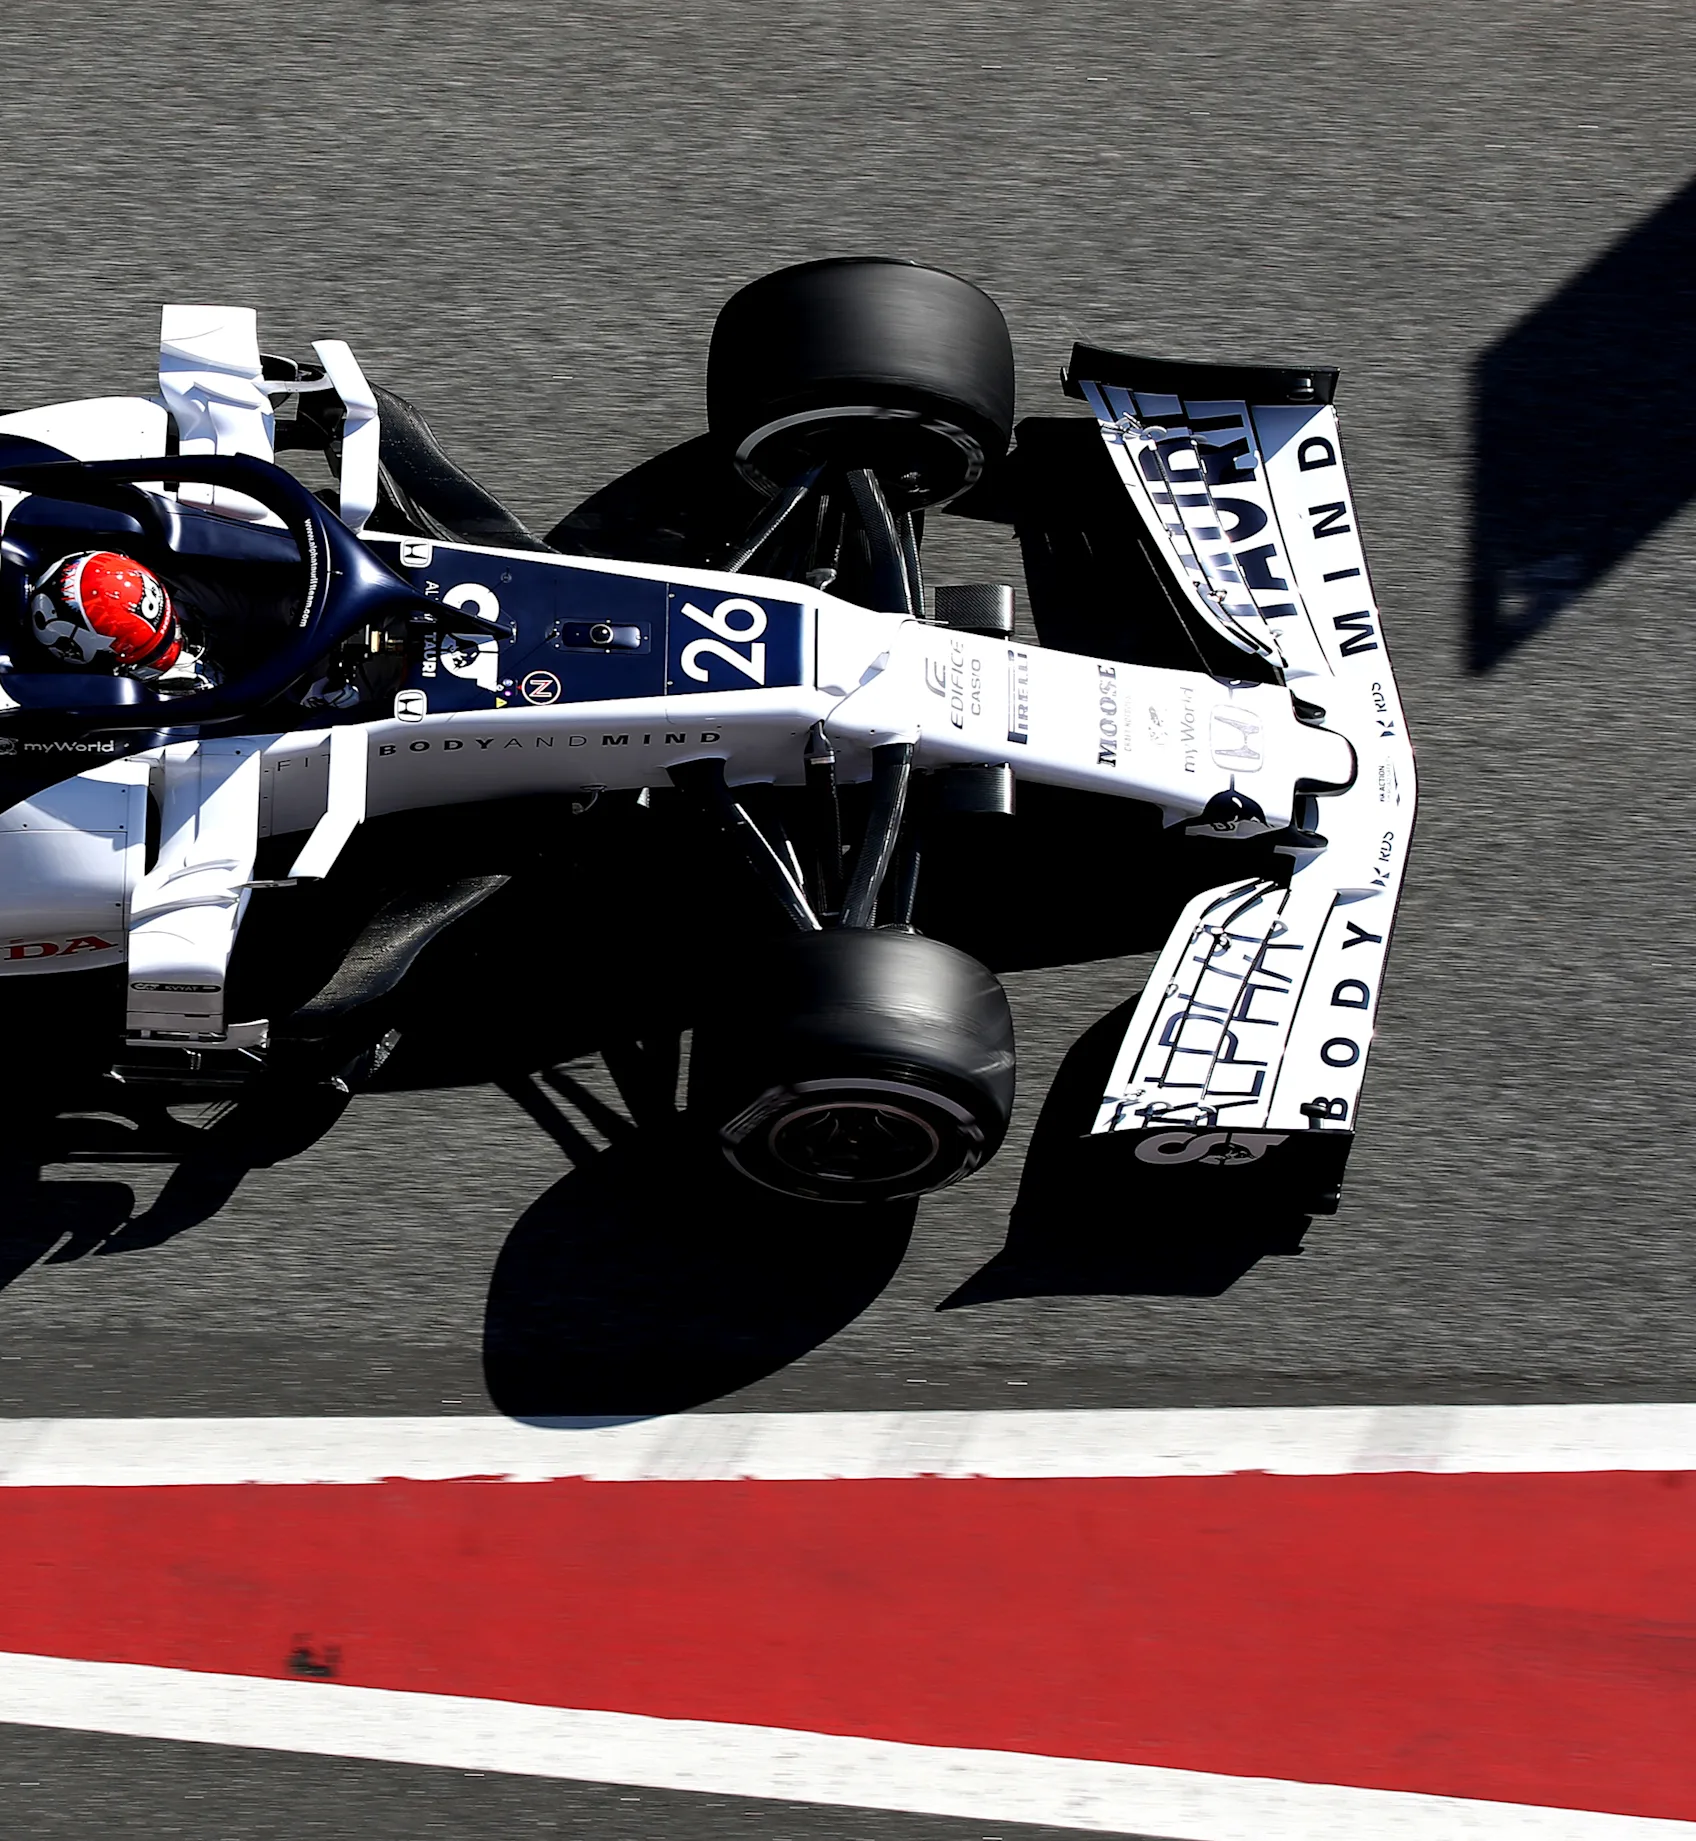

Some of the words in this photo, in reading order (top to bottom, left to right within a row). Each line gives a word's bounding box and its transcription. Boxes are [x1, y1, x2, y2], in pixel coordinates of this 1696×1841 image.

[1298, 436, 1378, 658] MIND
[680, 597, 767, 686] 26
[950, 639, 964, 730] EDIFICE
[971, 659, 981, 716] CASIO
[1096, 664, 1118, 768] MOOSE
[24, 740, 115, 754] myWorld
[1378, 765, 1386, 792] ACTION
[1313, 921, 1383, 1122] BODY
